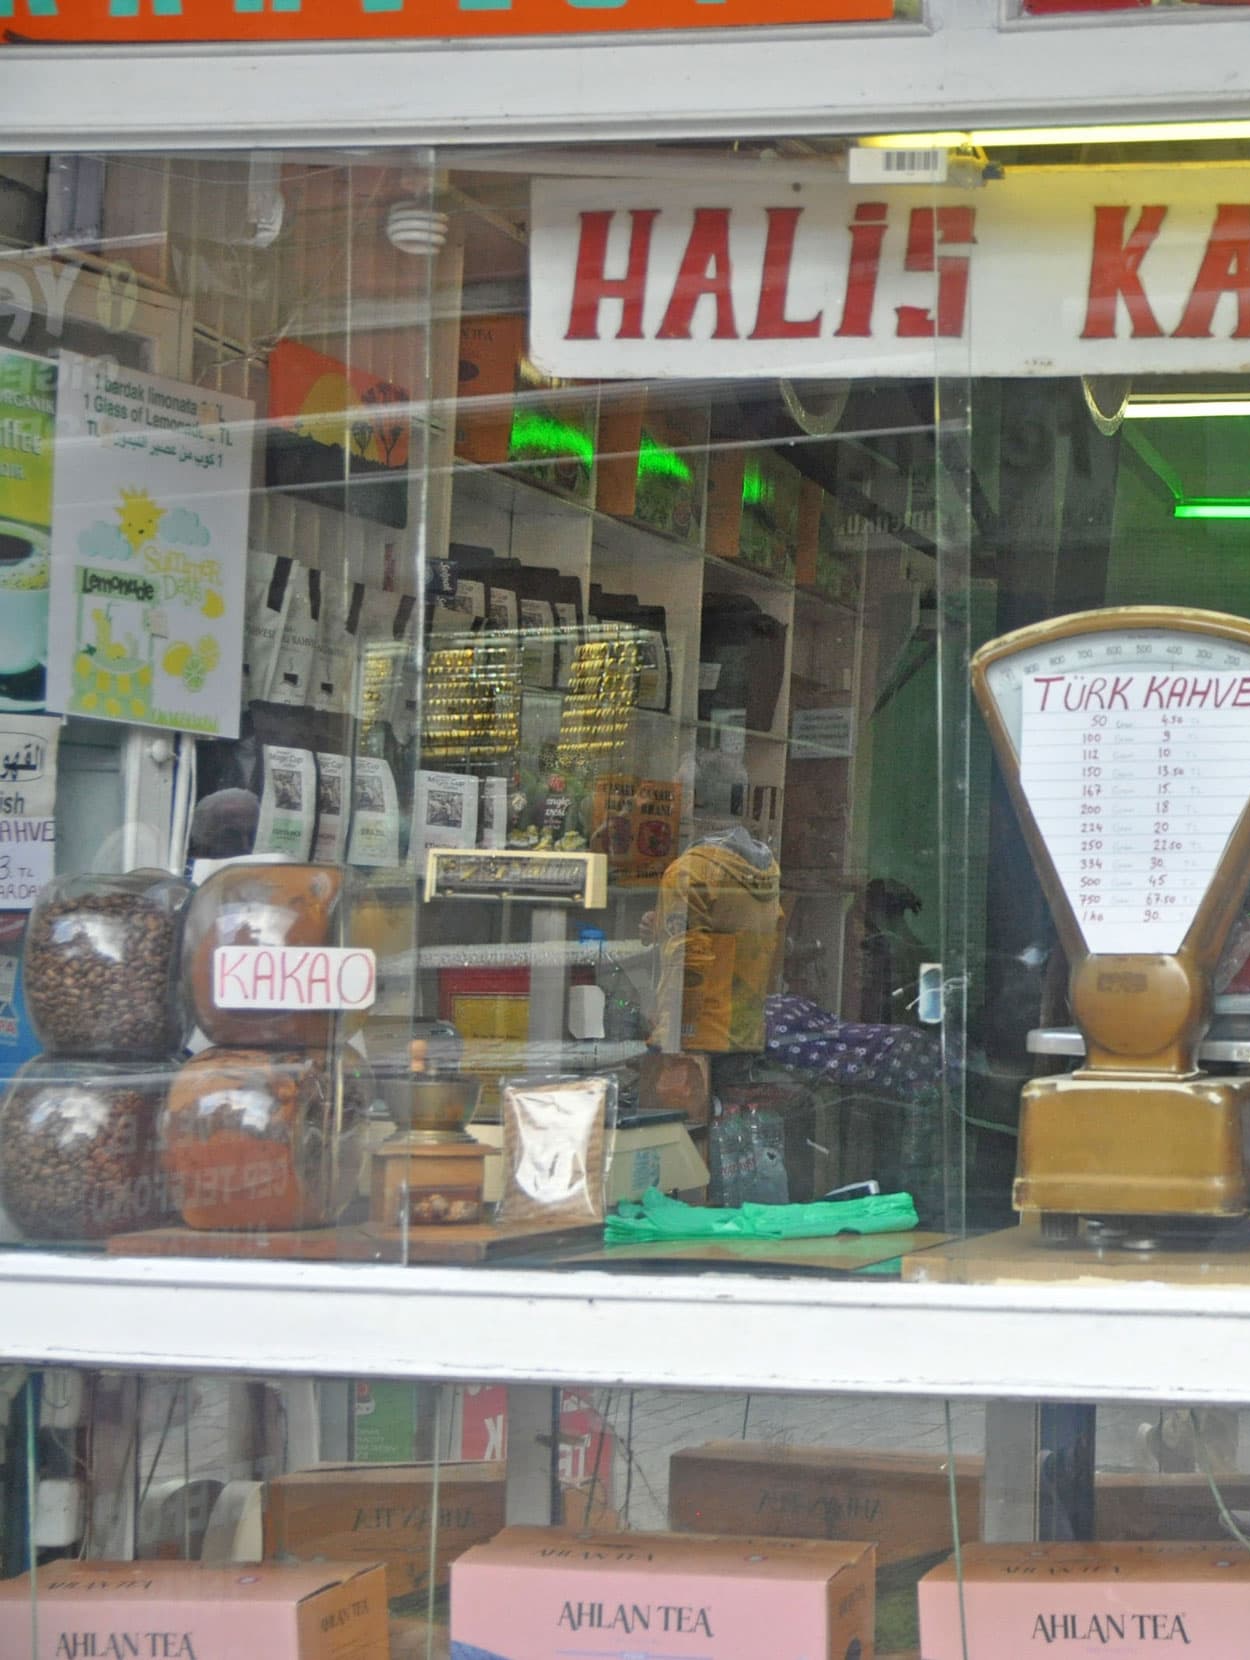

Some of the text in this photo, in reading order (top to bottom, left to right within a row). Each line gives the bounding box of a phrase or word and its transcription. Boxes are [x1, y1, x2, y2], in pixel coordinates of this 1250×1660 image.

[94, 395, 128, 419] Glass
[130, 407, 143, 423] of
[81, 567, 155, 601] Lemonade
[1034, 675, 1134, 711] TÜRK
[1090, 714, 1108, 727] 50
[1083, 733, 1101, 744] 100
[1162, 730, 1171, 742] 9
[1159, 748, 1171, 758] 10
[1082, 766, 1101, 778] 150
[1082, 784, 1103, 797] 167
[1081, 803, 1101, 815] 200
[1156, 800, 1170, 813] 18
[1154, 822, 1169, 834] 20
[1080, 840, 1103, 851] 250
[1080, 874, 1168, 888] 500 45
[220, 951, 374, 1004] KAKAO
[556, 1600, 715, 1639] AHLAN TEA
[1031, 1612, 1192, 1646] AHLAN TEA
[55, 1631, 198, 1660] AHLAN TEA
